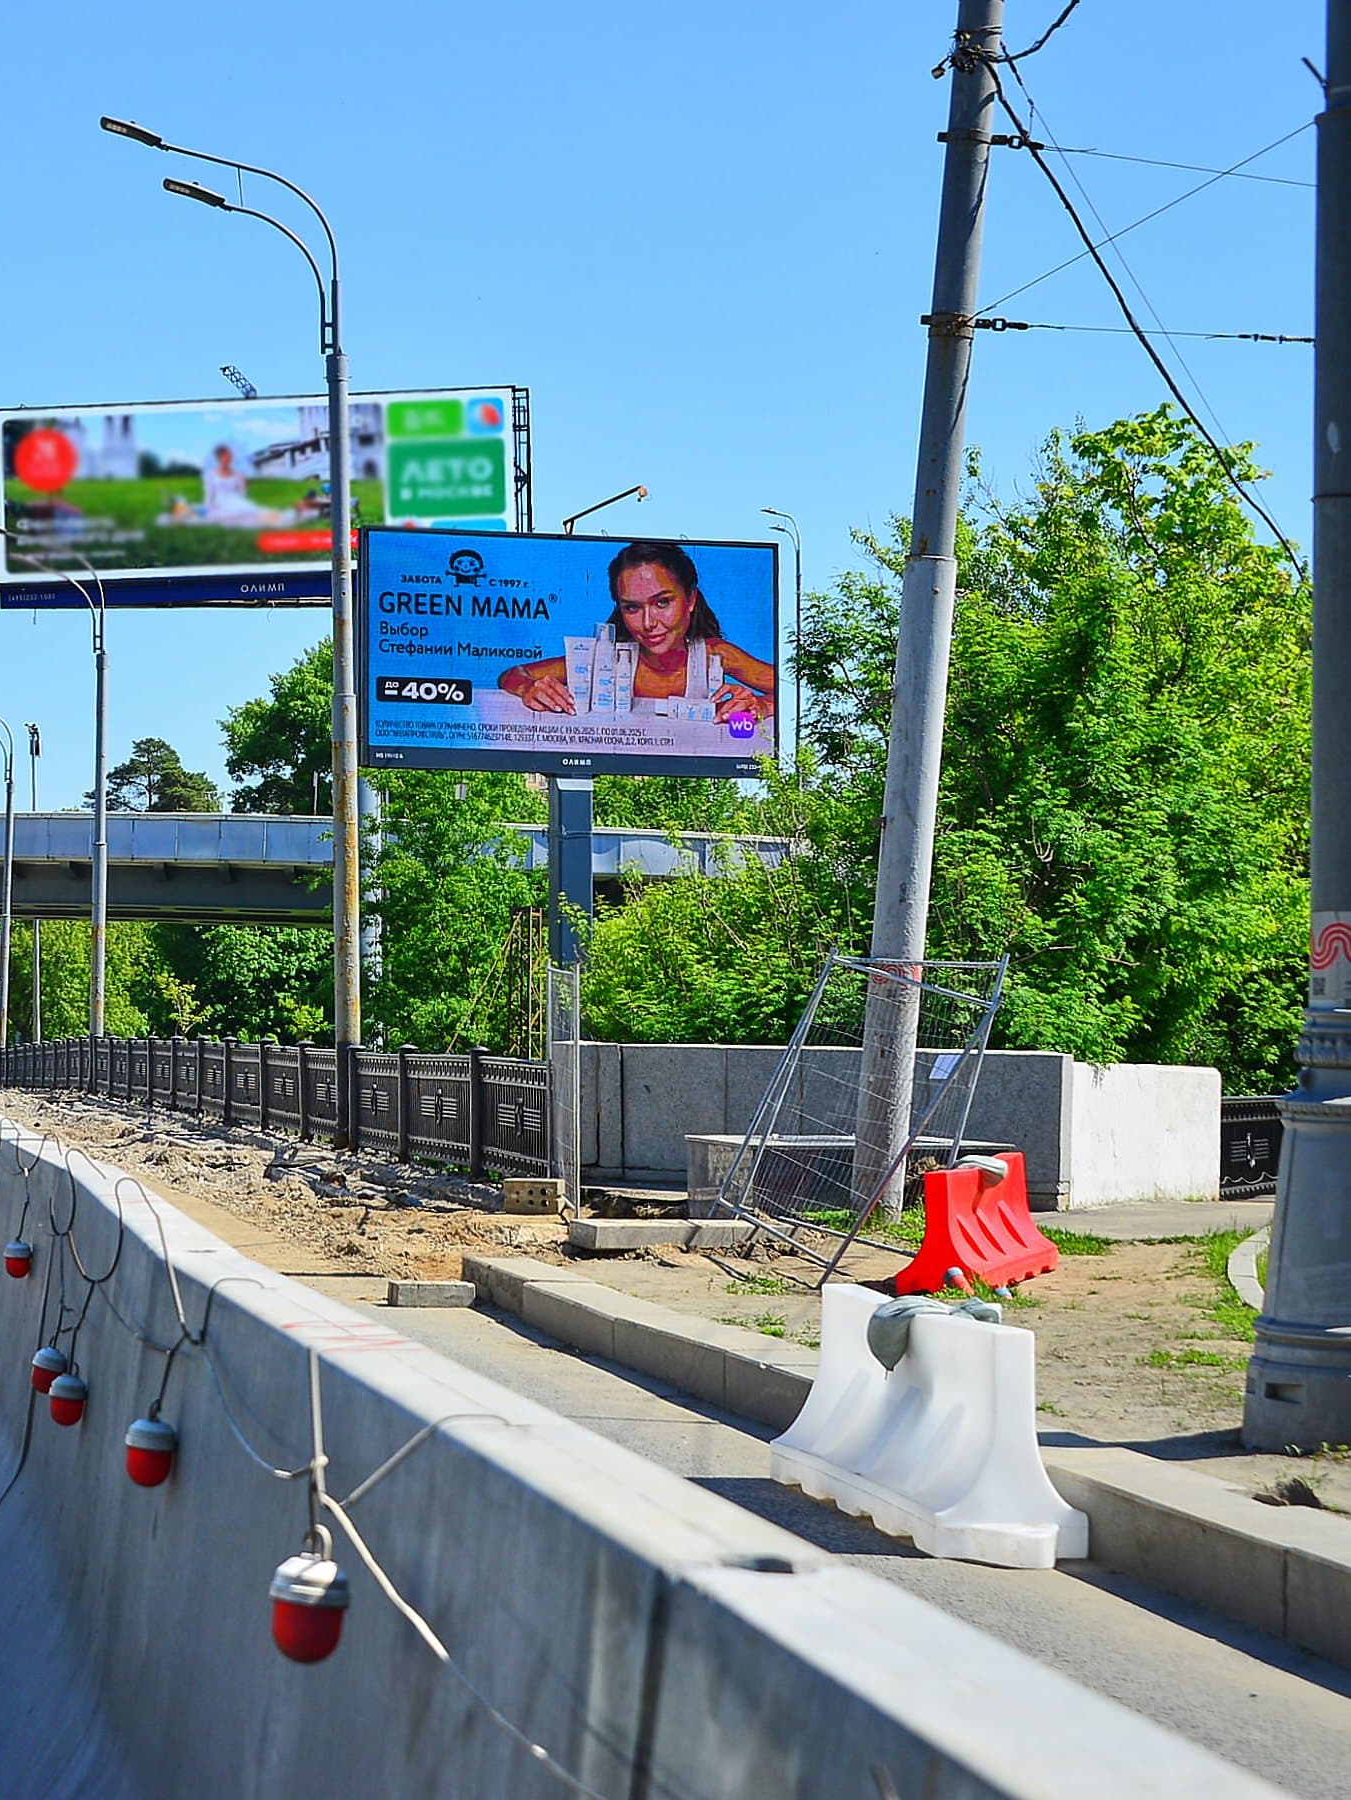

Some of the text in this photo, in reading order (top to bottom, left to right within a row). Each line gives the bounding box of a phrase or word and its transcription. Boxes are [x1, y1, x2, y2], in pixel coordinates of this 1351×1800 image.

[401, 575, 442, 584] ЗАБОТА
[498, 579, 522, 588] 1997
[240, 583, 285, 593] ОЛИМП
[379, 592, 462, 616] GREEN
[379, 621, 429, 639] Выбор
[379, 639, 543, 659] Стефании Маликовой
[730, 717, 753, 731] wb
[561, 758, 592, 766] ОЛИМП
